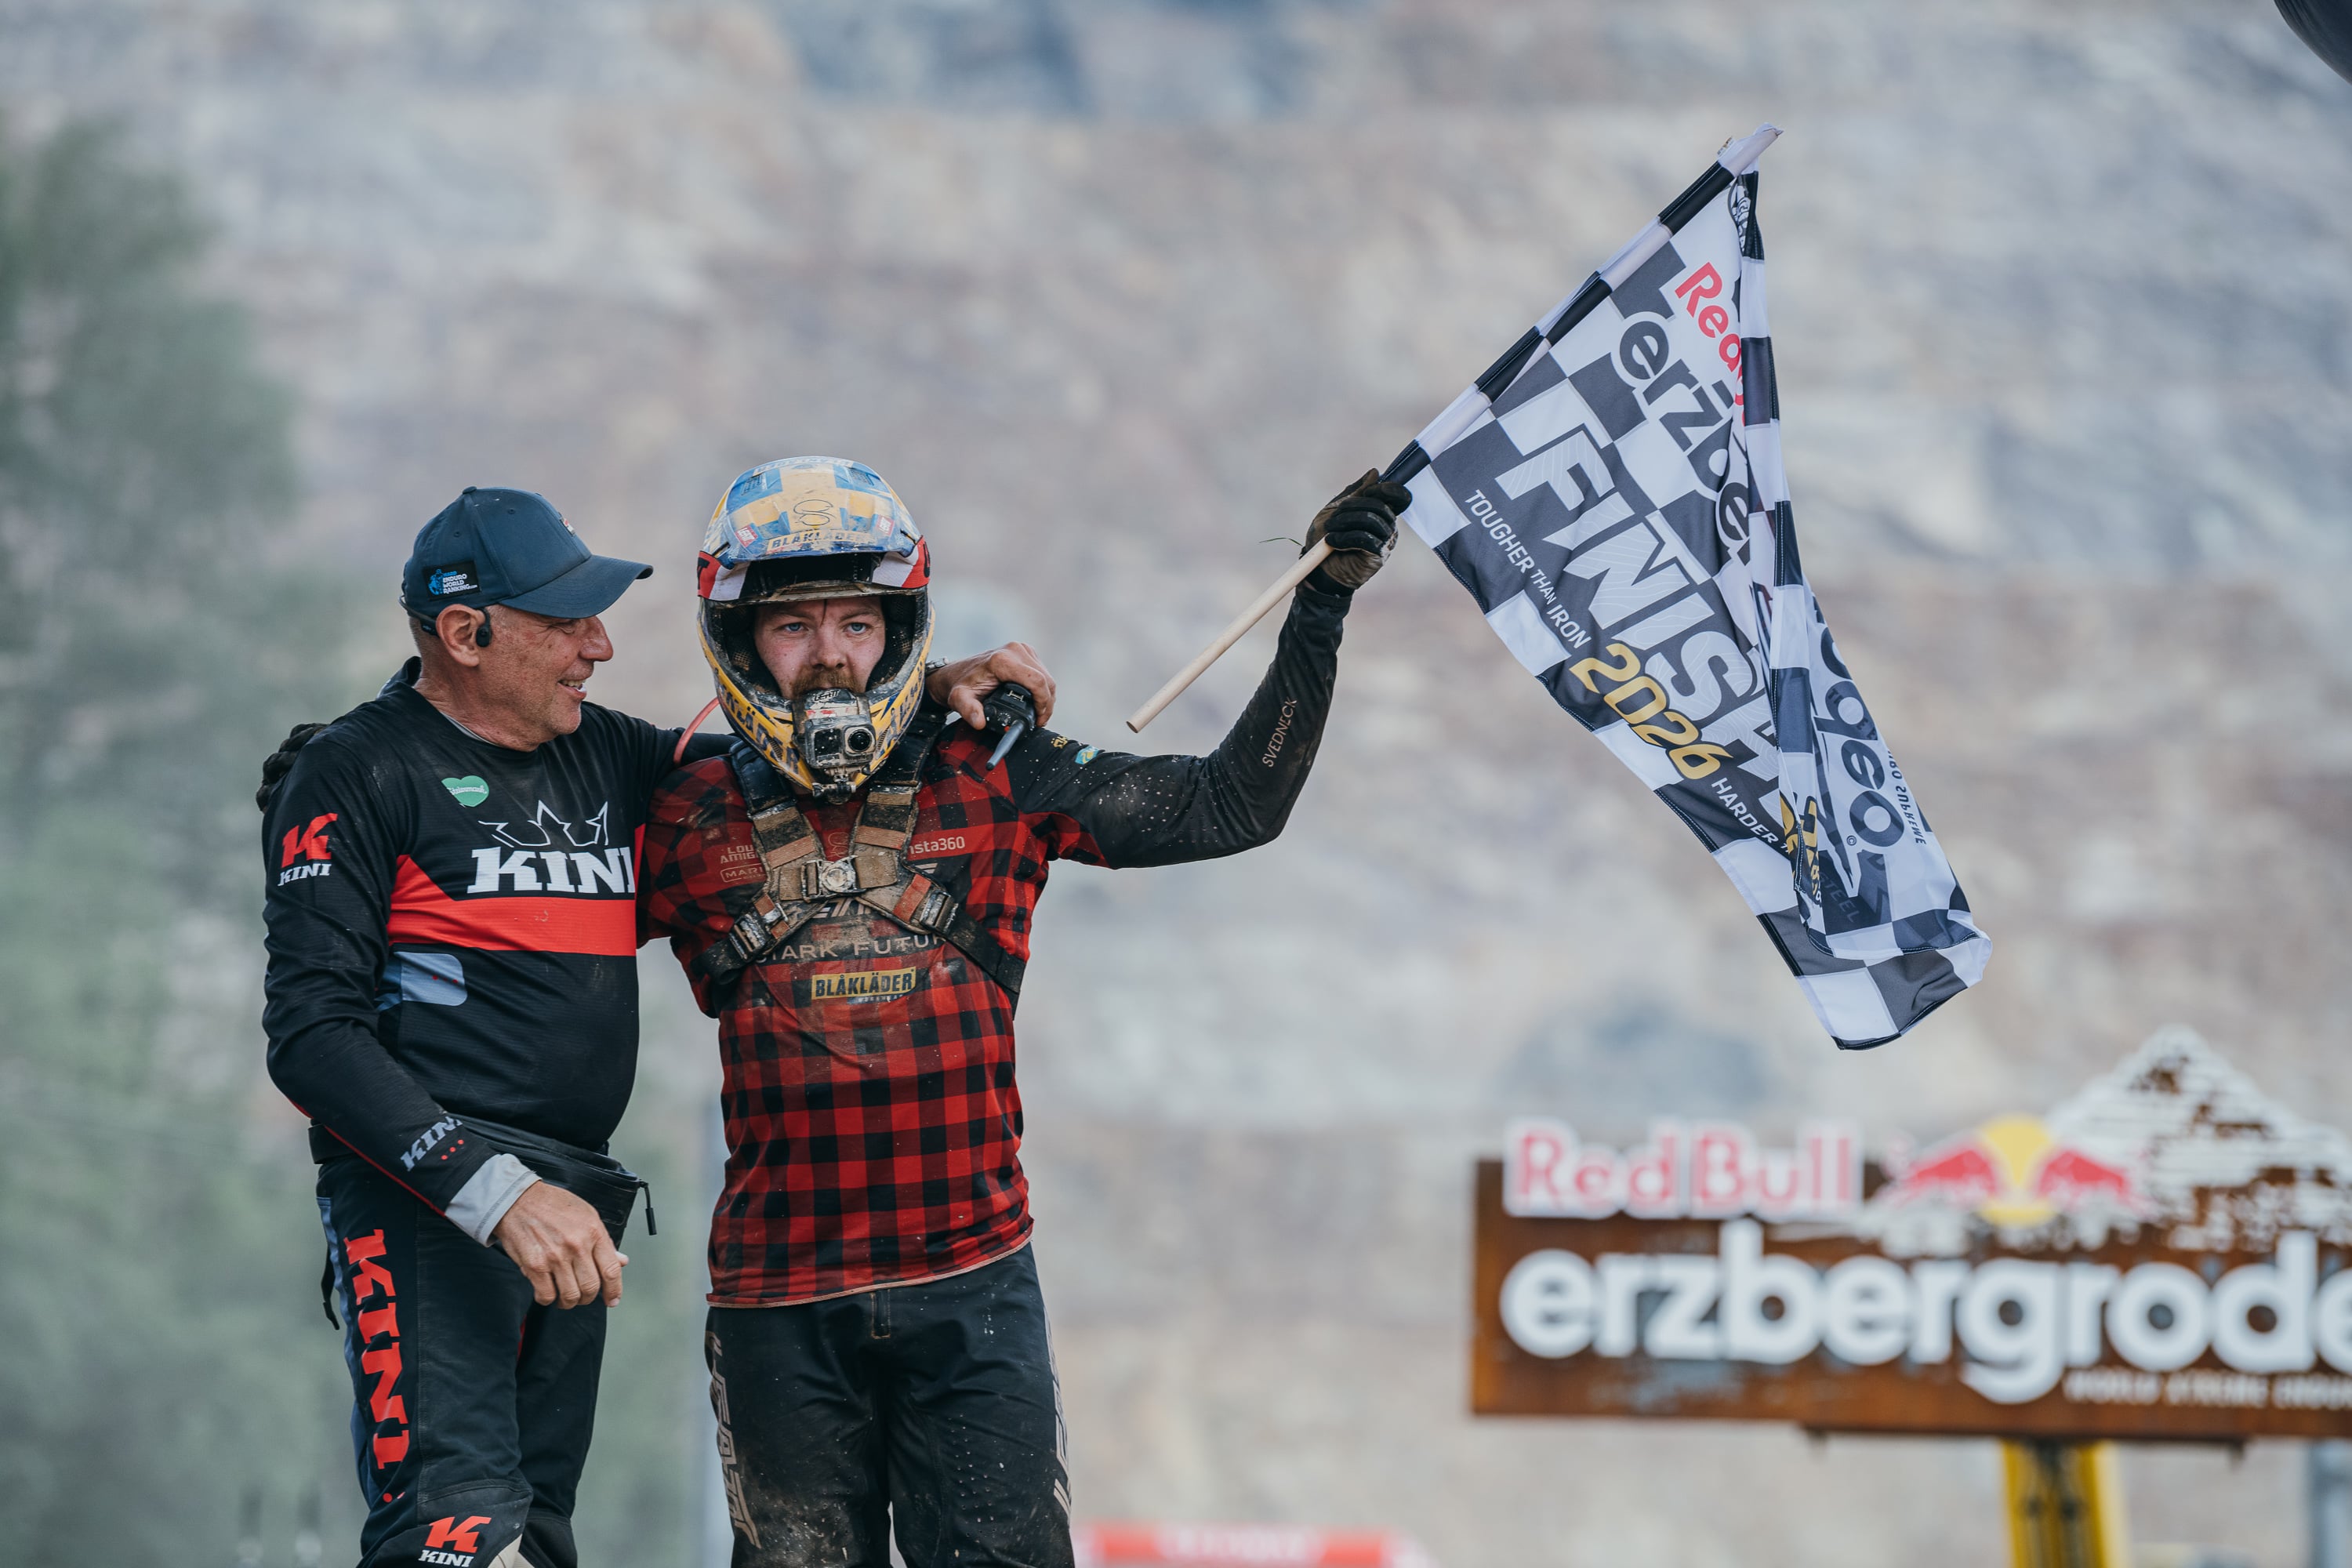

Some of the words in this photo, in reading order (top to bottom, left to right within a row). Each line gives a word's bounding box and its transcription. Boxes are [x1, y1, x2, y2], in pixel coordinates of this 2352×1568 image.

[1465, 489, 1534, 574] TOUGHER
[1530, 569, 1555, 605] THAN
[1547, 604, 1592, 649] IRON
[1569, 643, 1734, 779] 2026
[1261, 696, 1298, 768] SVEDNECK
[1711, 777, 1778, 844] HARDER
[720, 851, 758, 864] AMIG
[727, 844, 753, 855] LOU
[909, 836, 966, 855] nsta360
[277, 862, 332, 887] KINI
[467, 846, 636, 894] KINI
[725, 868, 764, 878] MARI
[815, 971, 913, 998] BLÅKLÄDER
[1515, 1127, 1681, 1212] Red
[1693, 1127, 1857, 1212] Bull
[343, 1229, 410, 1470] KINI
[418, 1549, 474, 1567] KINI
